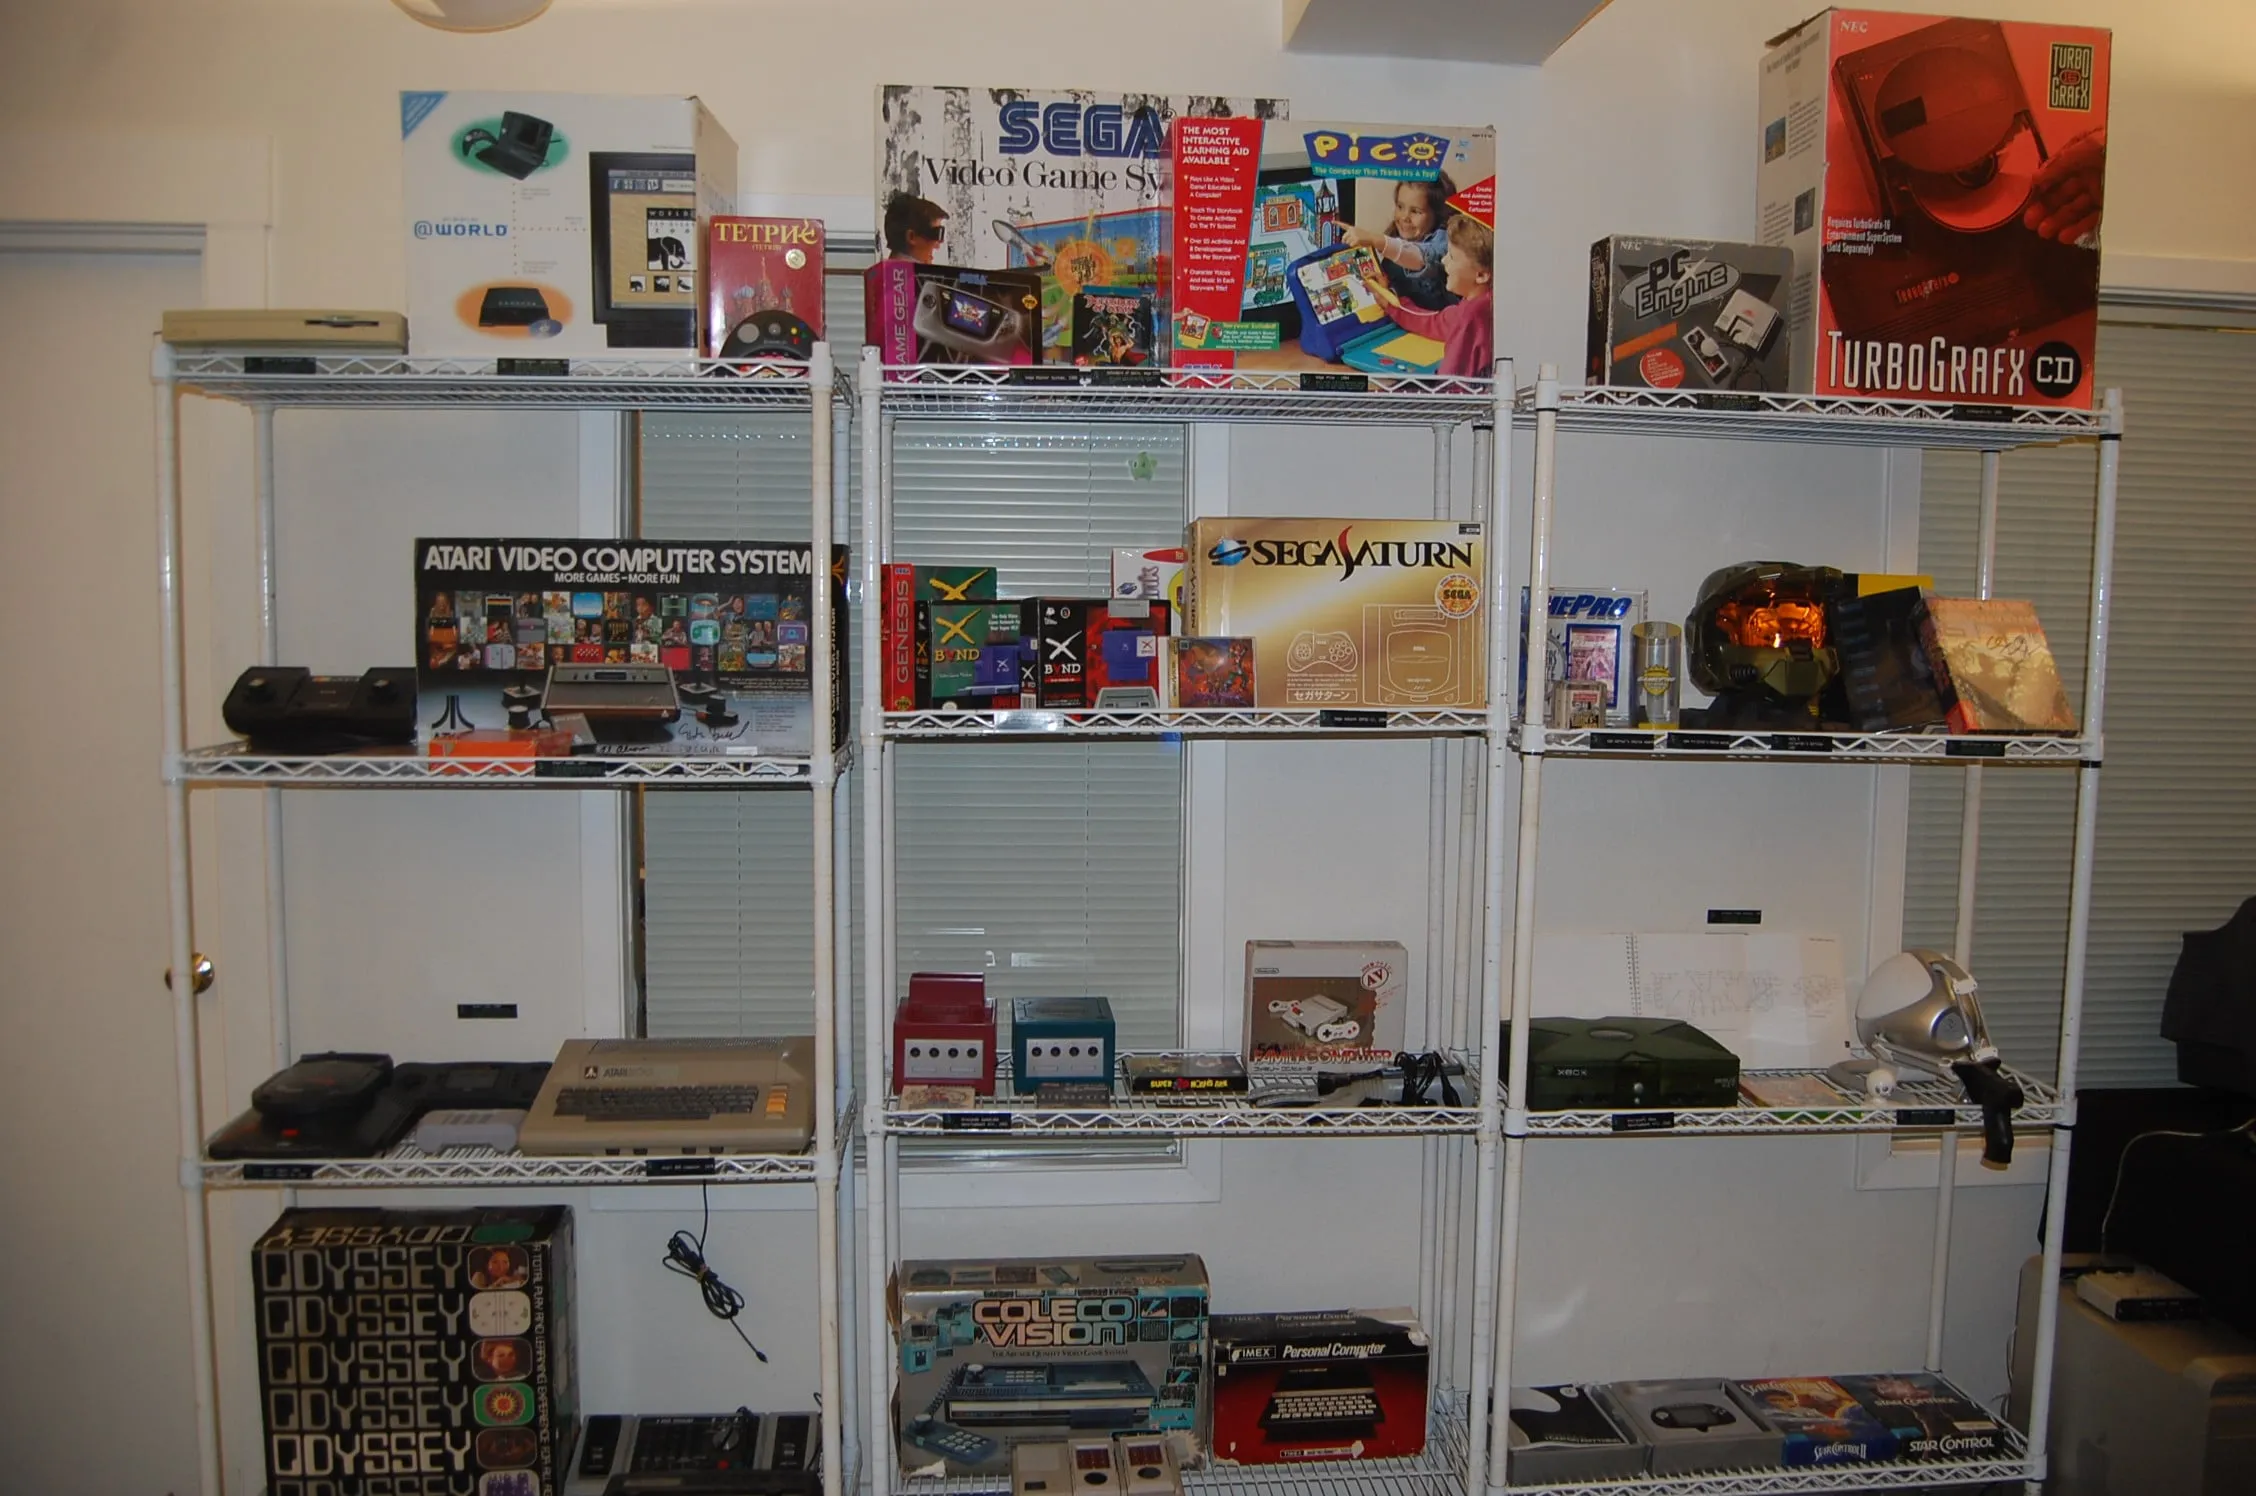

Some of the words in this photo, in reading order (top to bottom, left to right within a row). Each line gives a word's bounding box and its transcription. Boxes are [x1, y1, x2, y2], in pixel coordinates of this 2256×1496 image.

[1840, 21, 1868, 33] NEC
[2052, 45, 2090, 79] TURBO
[2051, 77, 2089, 109] GRAFX
[998, 101, 1172, 159] SEGA
[1182, 126, 1200, 135] THE
[1202, 127, 1230, 136] MOST
[1182, 136, 1241, 146] INTERACTIVE
[1182, 146, 1231, 155] LEARNING
[1232, 147, 1250, 156] AID
[1182, 156, 1230, 165] AVAILABLE
[923, 157, 1014, 188] Video
[1023, 161, 1117, 191] Game
[1619, 240, 1643, 251] NEC
[1648, 249, 1691, 289] PC
[893, 268, 906, 322] GEAR
[1635, 263, 1728, 320] Engine
[2036, 356, 2075, 385] CD
[424, 545, 492, 571] ATARI
[498, 546, 577, 572] VIDEO
[582, 547, 714, 574] COMPUTER
[716, 549, 812, 575] SYSTEM
[554, 572, 584, 583] MORE
[659, 573, 680, 584] FUN
[1443, 589, 1472, 600] SEGA
[896, 580, 909, 683] GENESIS
[1293, 690, 1350, 701] セガサターン
[1366, 968, 1384, 987] AV
[603, 1067, 628, 1077] ATARI
[1557, 1068, 1588, 1076] XBOX
[261, 1246, 463, 1292] ODYSSEY
[263, 1293, 465, 1338] ODYSSEY
[973, 1296, 1135, 1324] COLECO
[983, 1322, 1126, 1348] VISION
[266, 1339, 467, 1385] ODYSSEY
[1282, 1342, 1332, 1359] Personal
[1332, 1341, 1386, 1359] Computer
[269, 1386, 469, 1431] ODYSSEY
[271, 1430, 472, 1476] ODYSSEY
[1909, 1440, 1938, 1452] STAR
[1939, 1434, 1995, 1454] CONTROL
